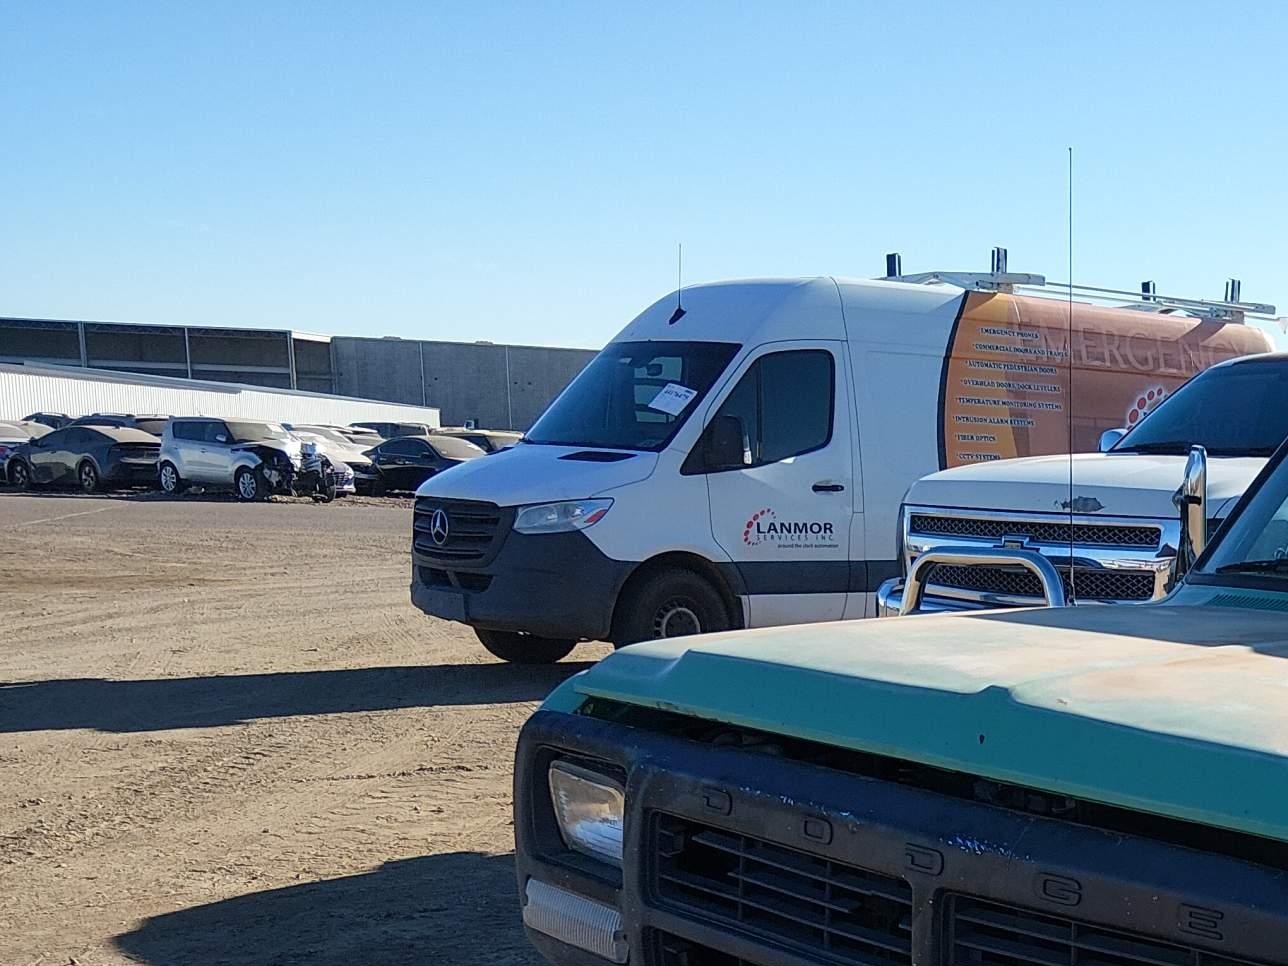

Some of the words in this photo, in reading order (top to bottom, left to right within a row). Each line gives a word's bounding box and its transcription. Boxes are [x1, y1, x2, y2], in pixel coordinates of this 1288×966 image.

[980, 327, 1015, 337] EMERGENCY
[1016, 331, 1038, 339] PHONES
[1033, 348, 1045, 356] AND
[968, 360, 1002, 370] AUTOMATIC
[1003, 363, 1038, 373] PEDESTRIAN
[1039, 367, 1057, 375] DOORS
[963, 378, 995, 387] OVERHEAD
[959, 397, 1001, 406] TEMPERATURE
[1001, 400, 1037, 409] MONITORING
[1037, 403, 1062, 411] SYSTEMS
[955, 415, 987, 423] INTRUSION
[1009, 419, 1034, 427] SYSTEMS
[756, 521, 834, 535] LANMOR
[700, 786, 1224, 941] DODGE
